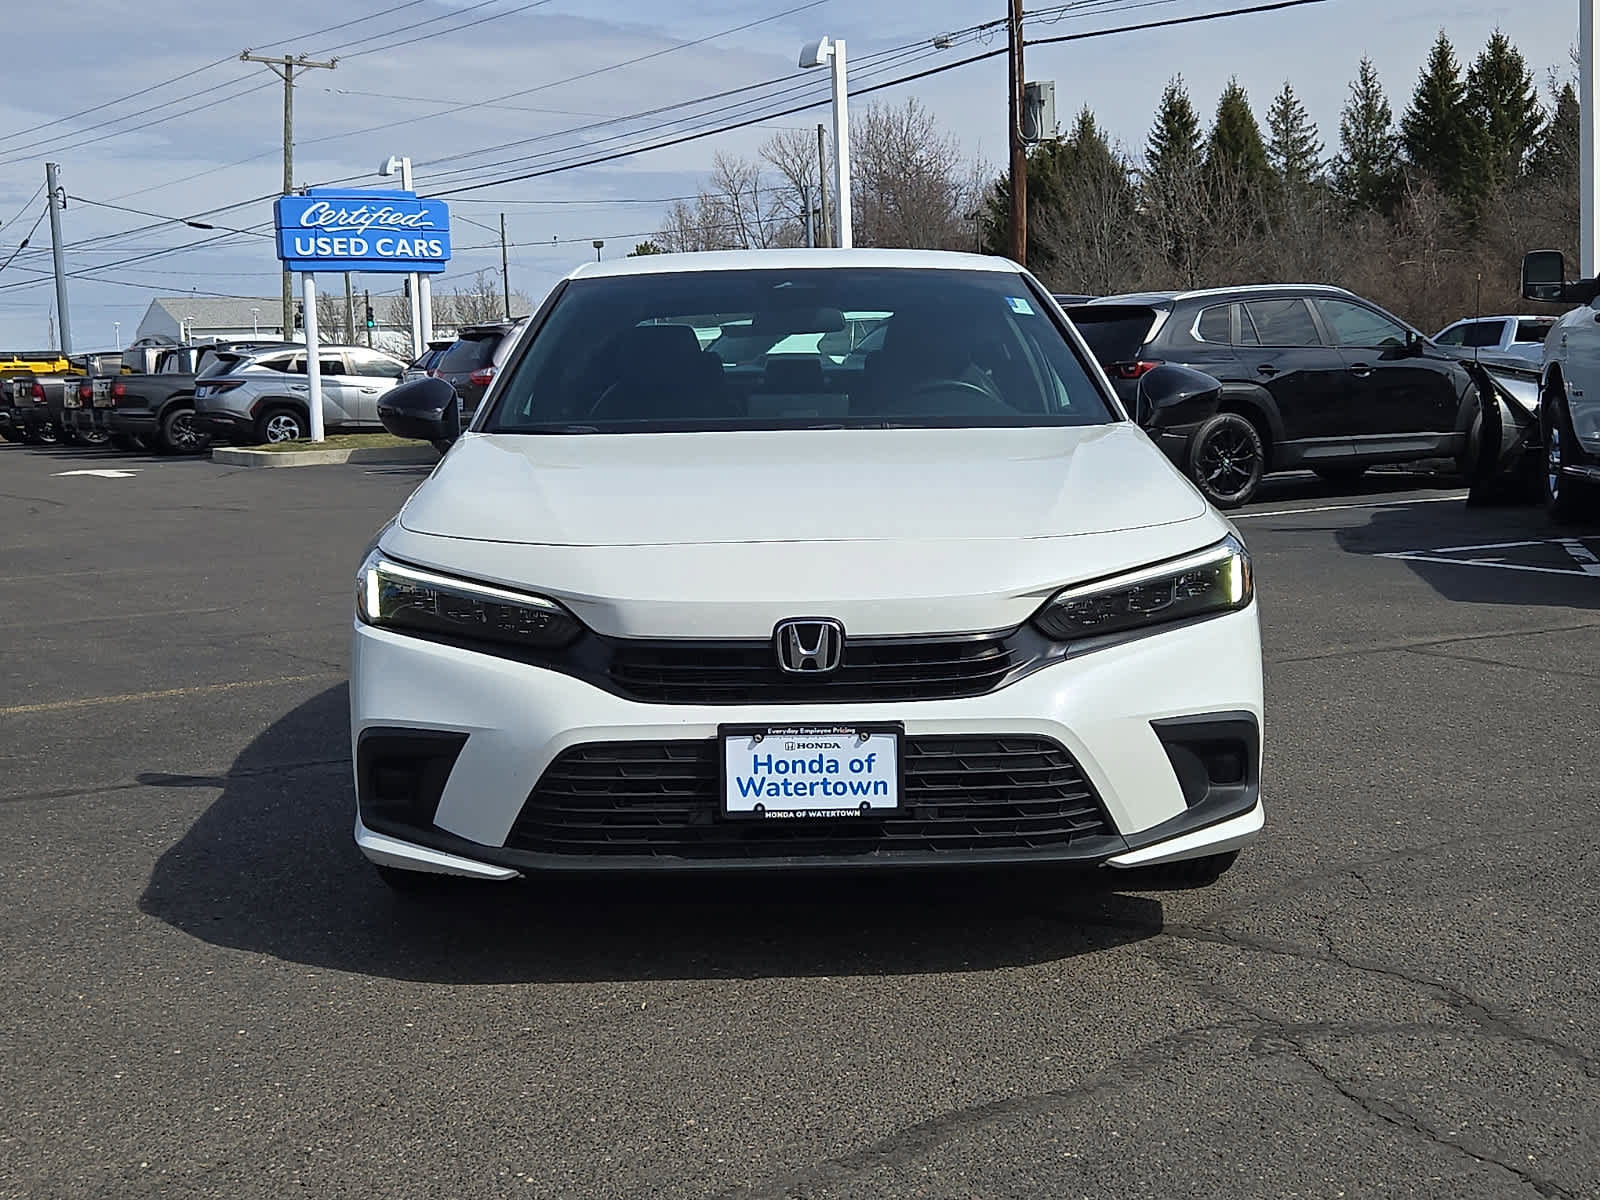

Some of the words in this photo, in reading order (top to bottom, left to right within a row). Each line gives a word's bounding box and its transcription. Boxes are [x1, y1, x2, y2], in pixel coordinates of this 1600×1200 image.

[300, 201, 434, 235] Certified
[295, 237, 369, 256] USED
[375, 238, 443, 257] CARS
[832, 726, 856, 734] Pricing
[753, 753, 839, 774] Honda
[849, 752, 876, 773] of
[736, 776, 888, 798] Watertown
[808, 810, 861, 818] WATERTOWN
